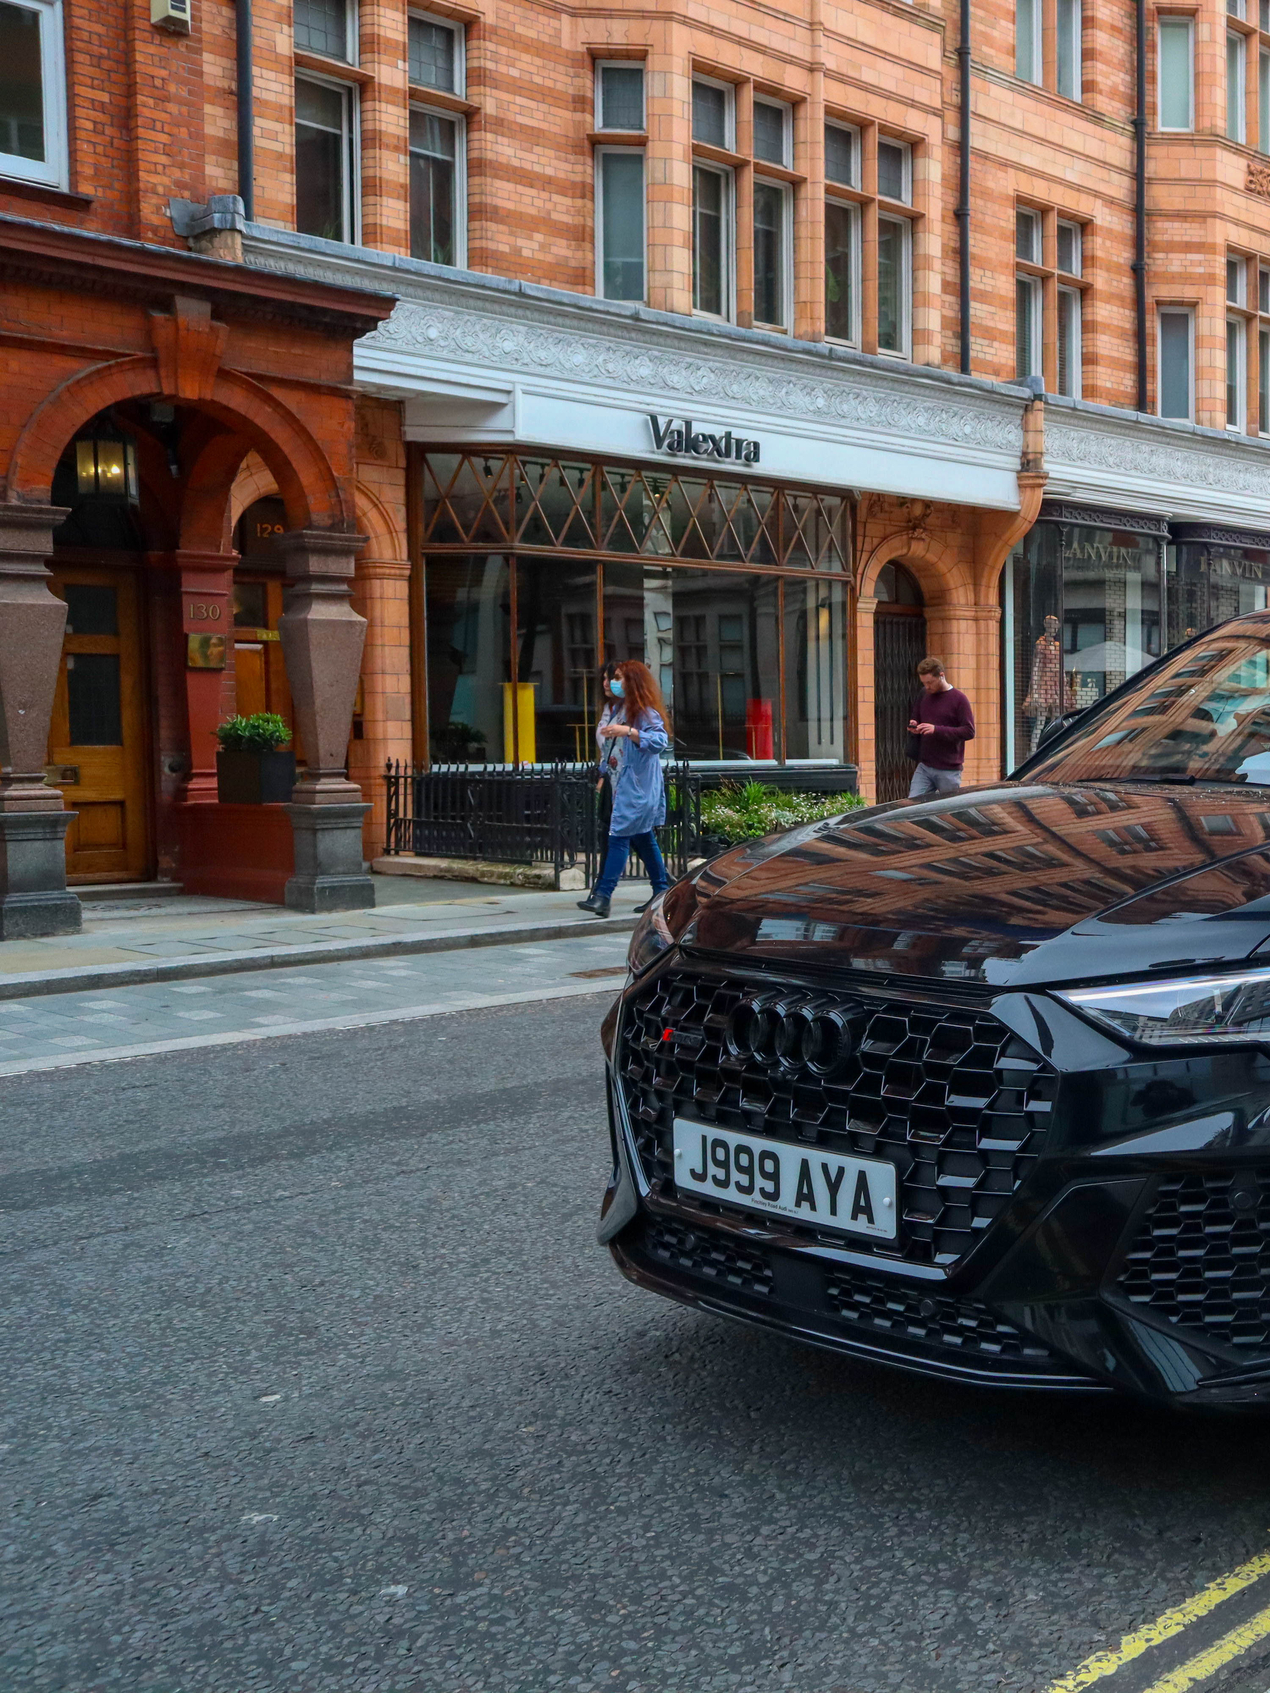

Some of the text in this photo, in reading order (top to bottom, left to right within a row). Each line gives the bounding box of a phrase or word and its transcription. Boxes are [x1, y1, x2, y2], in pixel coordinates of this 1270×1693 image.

[646, 414, 760, 463] Valextra
[257, 523, 285, 538] 129
[189, 603, 221, 621] 130
[689, 1134, 875, 1225] J999 AYA
